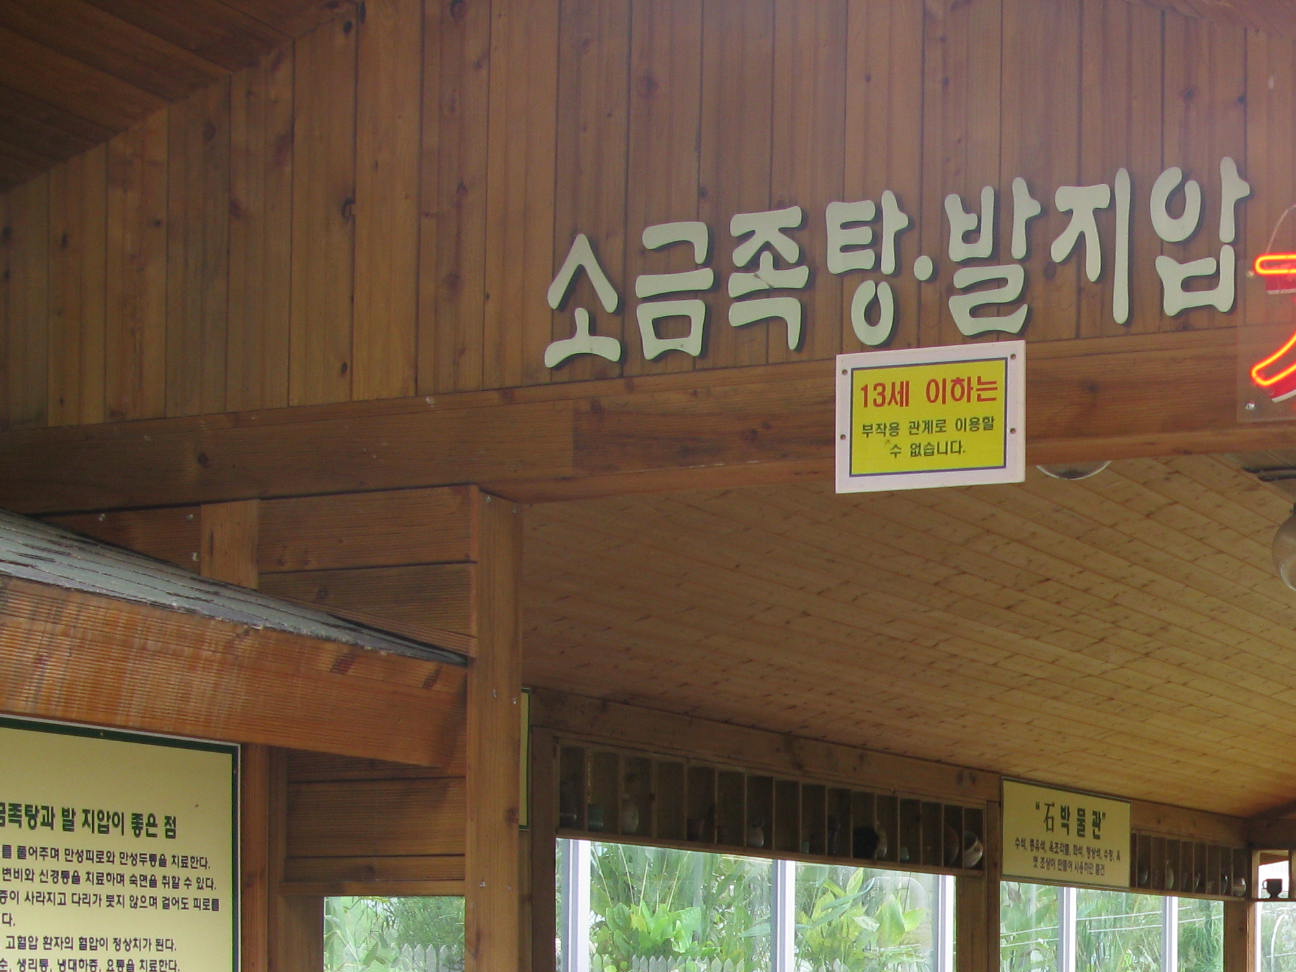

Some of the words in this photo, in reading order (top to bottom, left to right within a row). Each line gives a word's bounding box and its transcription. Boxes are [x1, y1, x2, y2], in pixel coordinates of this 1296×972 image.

[861, 380, 910, 408] 13세
[925, 375, 998, 405] 이하는
[862, 421, 900, 438] 부작용
[908, 419, 947, 436] 관계로
[955, 416, 995, 432] 이용할
[890, 443, 902, 458] 수
[910, 439, 966, 458] 없습니다.
[61, 807, 76, 832] 발
[82, 809, 124, 836] 지압이
[131, 813, 158, 838] 좋은
[164, 815, 176, 839] 점
[17, 845, 59, 862] 풀어주며
[64, 848, 115, 864] 만성피로와
[120, 851, 167, 868] 만성두통을
[171, 854, 210, 869] 치료한다.
[2, 867, 35, 883] 변비와
[40, 869, 81, 885] 신경통을
[85, 871, 125, 888] 치료하며
[129, 873, 157, 888] 숙면을
[162, 875, 180, 890] 취할
[184, 877, 193, 890] 수
[196, 876, 217, 891] 있다.
[24, 891, 67, 907] 사라지고
[71, 892, 102, 908] 다리가
[129, 894, 158, 910] 않으며
[162, 896, 190, 911] 걸어도
[193, 897, 220, 912] 피로를
[5, 935, 39, 951] 고혈압
[42, 935, 74, 951] 환자의
[78, 936, 109, 952] 혈압이
[113, 937, 152, 952] 정상치가
[155, 937, 177, 952] 된다.
[139, 958, 180, 972] 치료한다.
